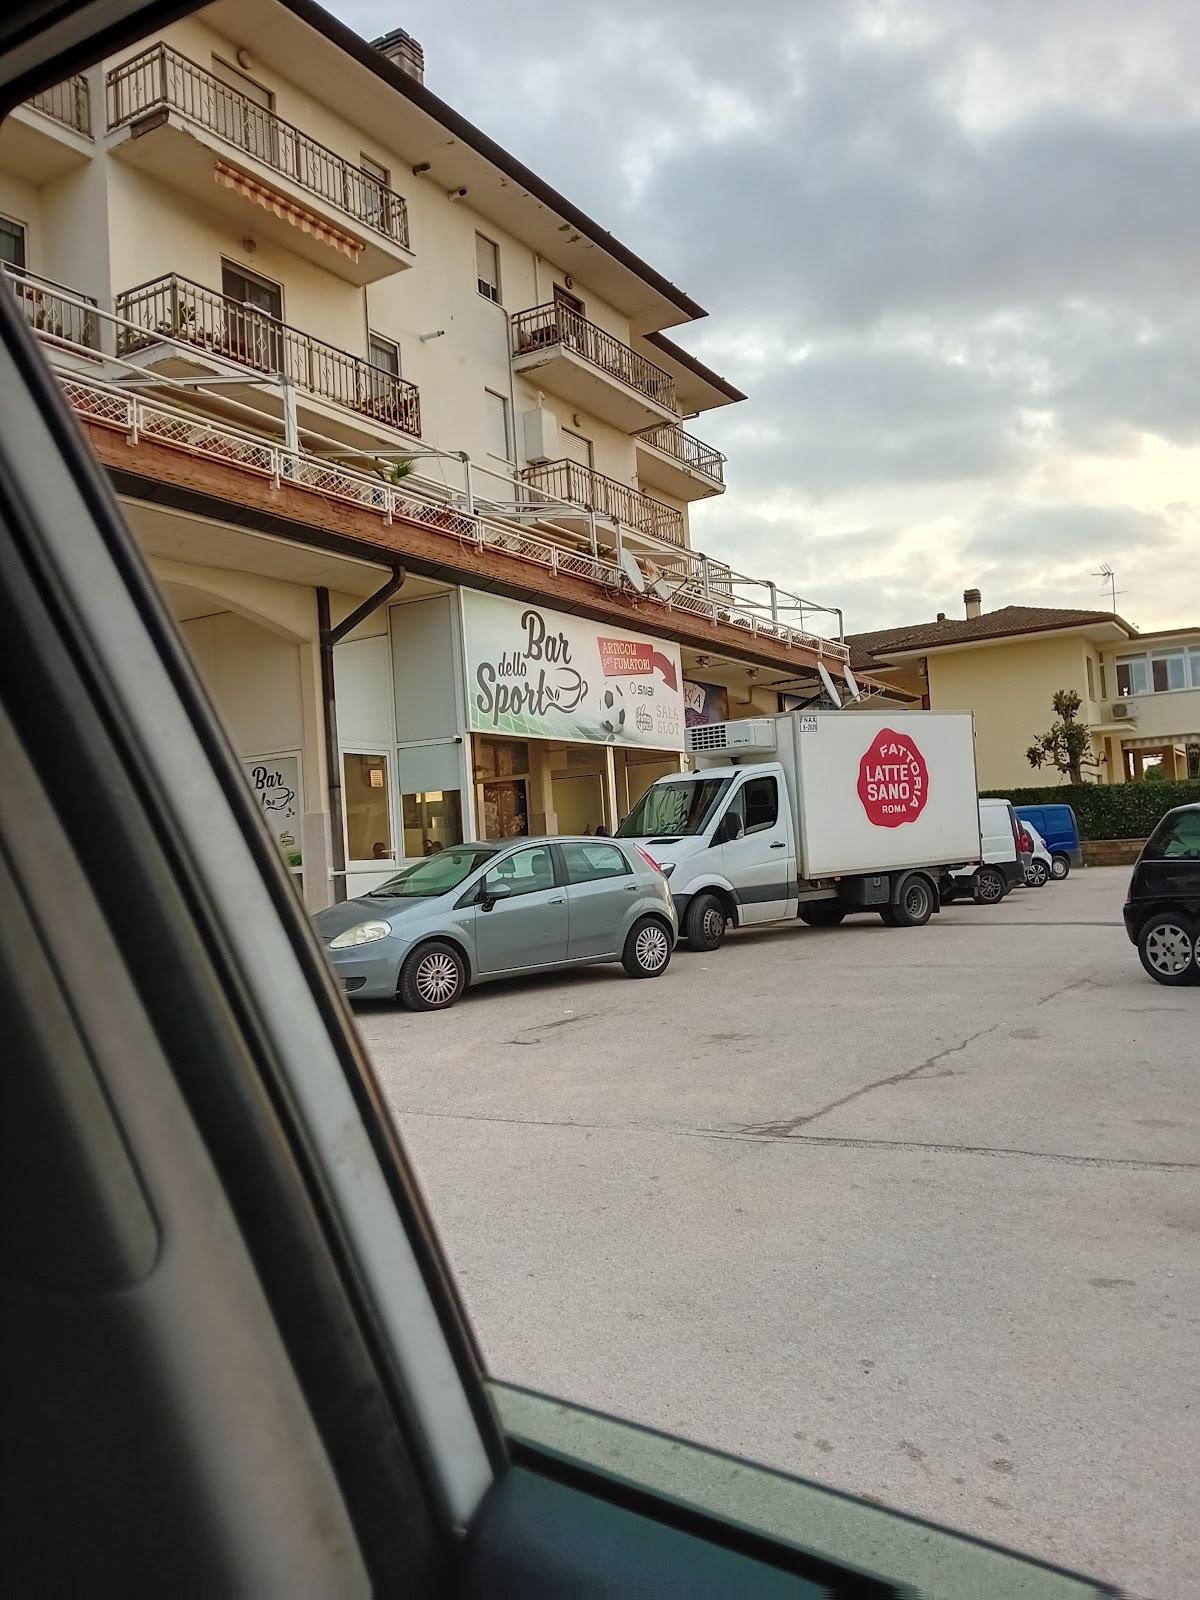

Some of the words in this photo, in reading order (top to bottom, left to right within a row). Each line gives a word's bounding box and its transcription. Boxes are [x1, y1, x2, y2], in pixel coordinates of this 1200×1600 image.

[521, 610, 572, 664] Bar
[602, 642, 637, 656] ARTICOLI
[498, 652, 527, 677] dello
[614, 658, 650, 670] FUMATORI
[476, 661, 546, 726] Sport
[656, 704, 679, 720] SALA
[657, 720, 680, 736] SLOT
[252, 766, 283, 790] Bar
[866, 764, 909, 782] LATTE
[879, 743, 922, 808] FATTORIA
[867, 783, 910, 802] SANO
[882, 804, 907, 814] ROMA
